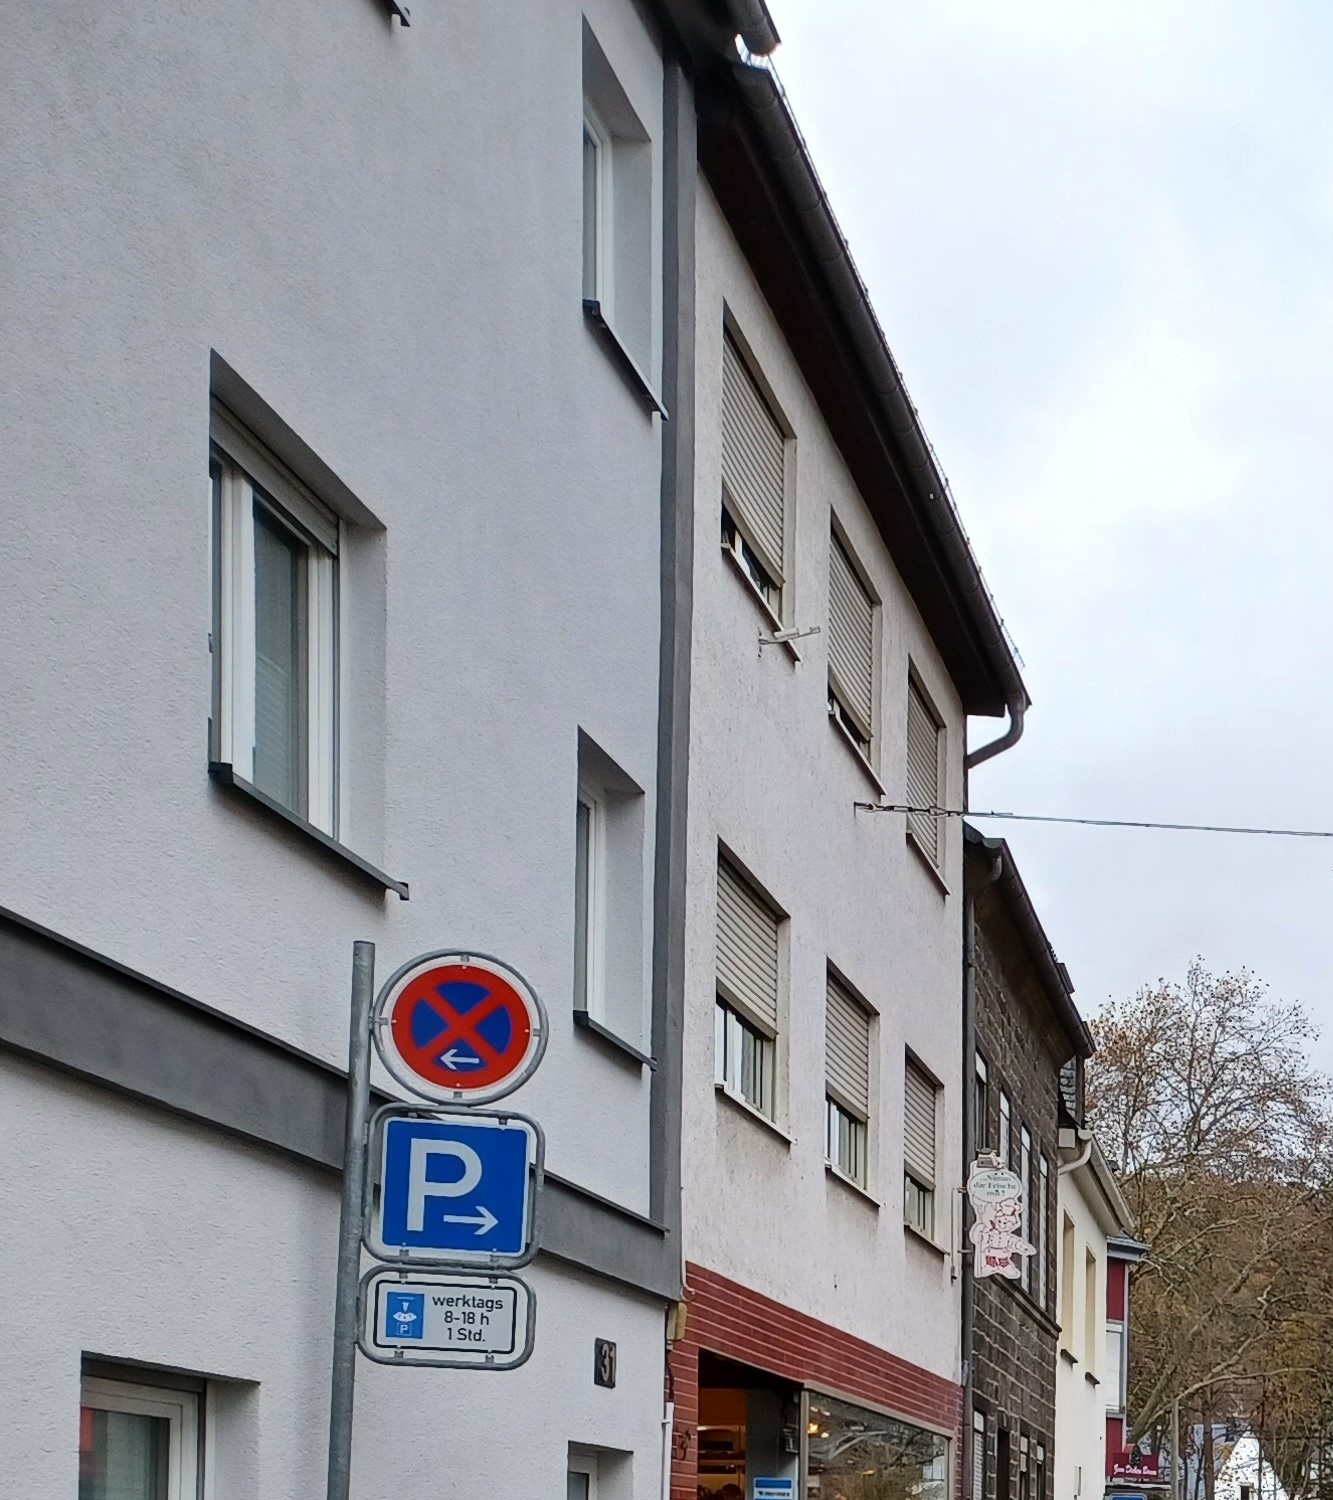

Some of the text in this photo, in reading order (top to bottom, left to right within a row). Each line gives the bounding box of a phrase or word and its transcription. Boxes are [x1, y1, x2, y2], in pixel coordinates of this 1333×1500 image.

[407, 1137, 483, 1232] P
[432, 1294, 504, 1313] werktags
[444, 1310, 490, 1326] 8-18 h
[447, 1327, 486, 1342] 1 Std.
[602, 1343, 616, 1383] 31
